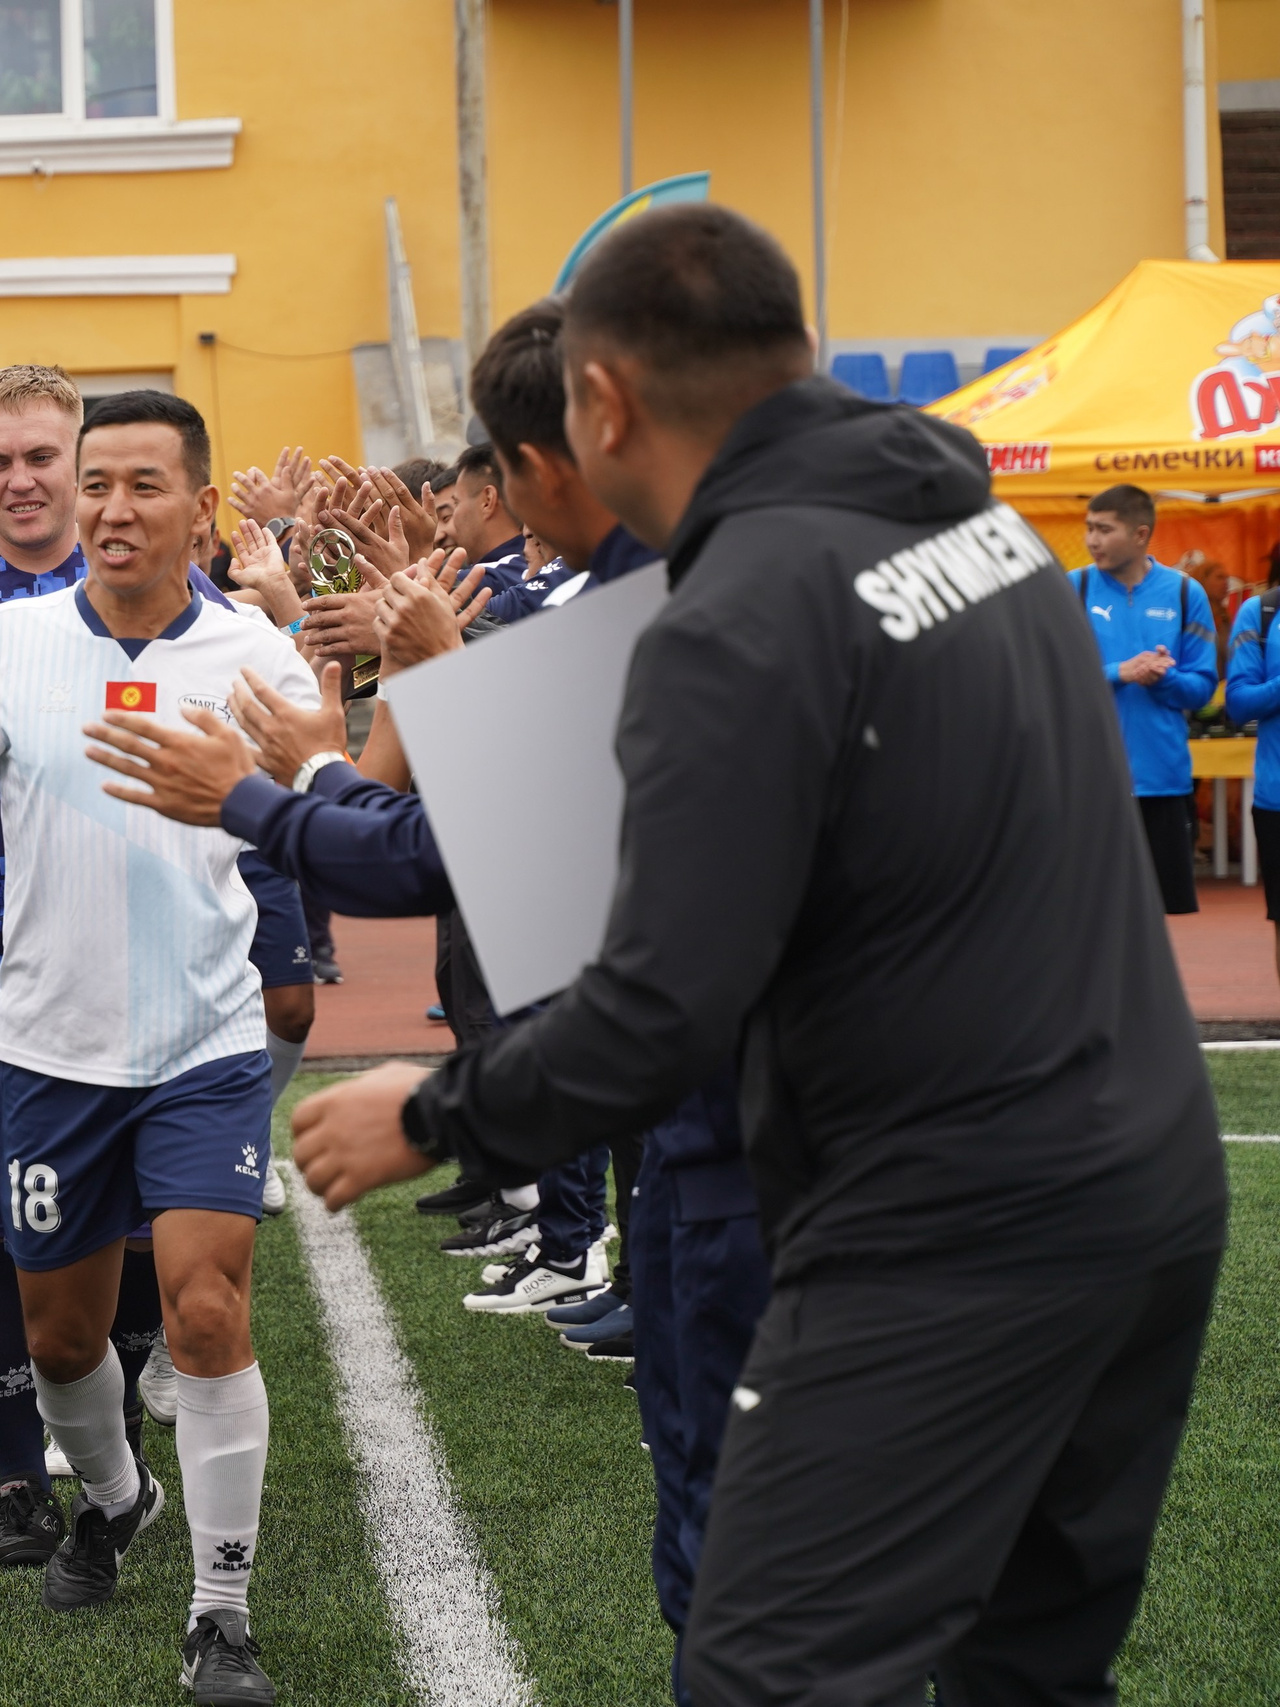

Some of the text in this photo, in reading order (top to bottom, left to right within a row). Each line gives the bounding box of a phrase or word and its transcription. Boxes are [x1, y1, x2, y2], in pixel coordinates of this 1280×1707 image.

[1094, 449, 1245, 472] семечки
[8, 1158, 62, 1233] 18
[522, 1271, 554, 1295] BOSS
[213, 1561, 252, 1572] KELME
